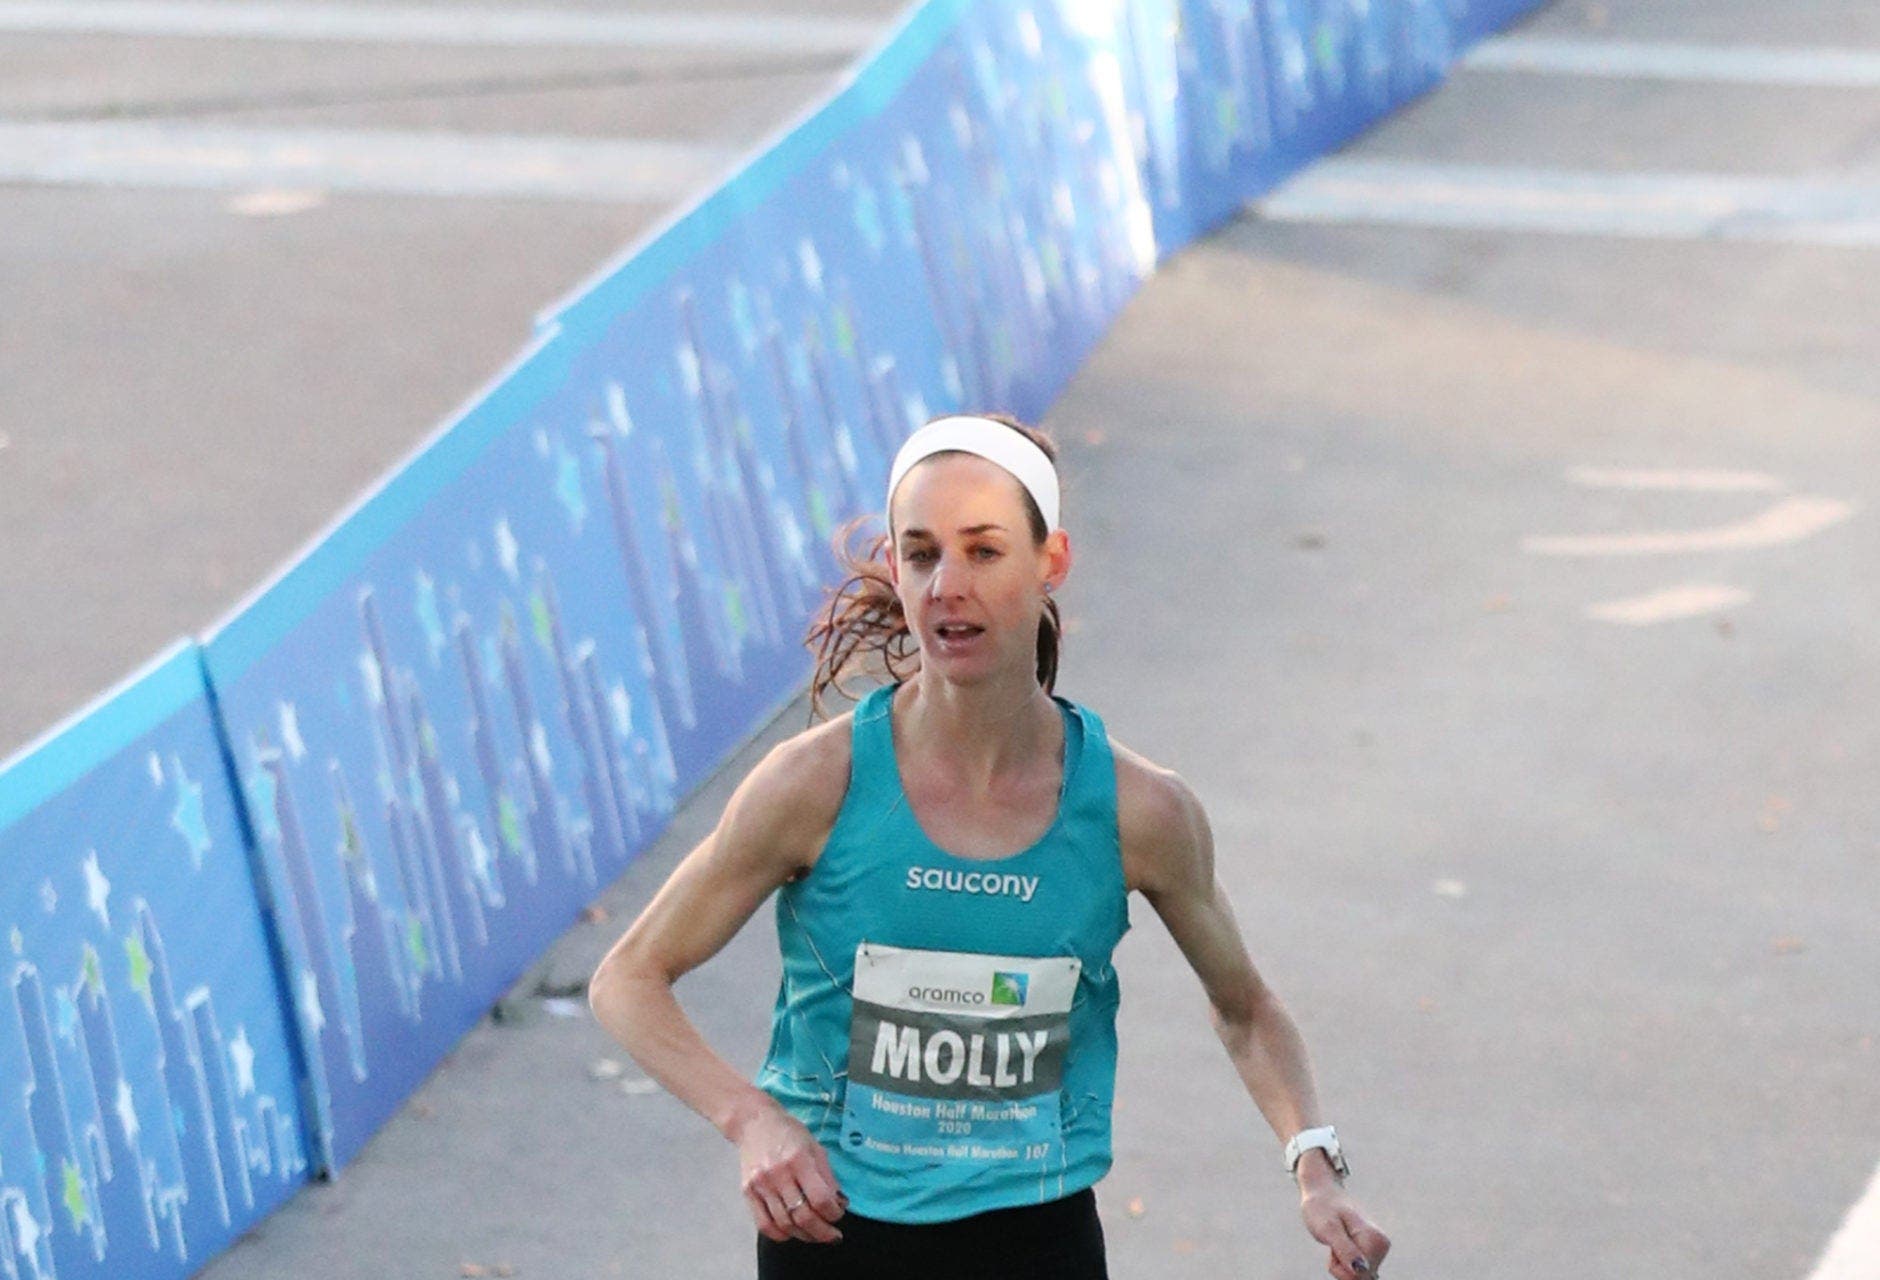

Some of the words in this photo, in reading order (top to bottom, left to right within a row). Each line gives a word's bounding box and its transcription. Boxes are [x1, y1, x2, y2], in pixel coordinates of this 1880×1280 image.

[906, 866, 1039, 902] saucony
[908, 985, 985, 1005] aramco
[871, 1020, 1048, 1088] MOLLY
[872, 1093, 930, 1118] Houston
[935, 1102, 966, 1119] Half
[971, 1102, 1037, 1121] Marathon
[938, 1121, 972, 1135] 2020
